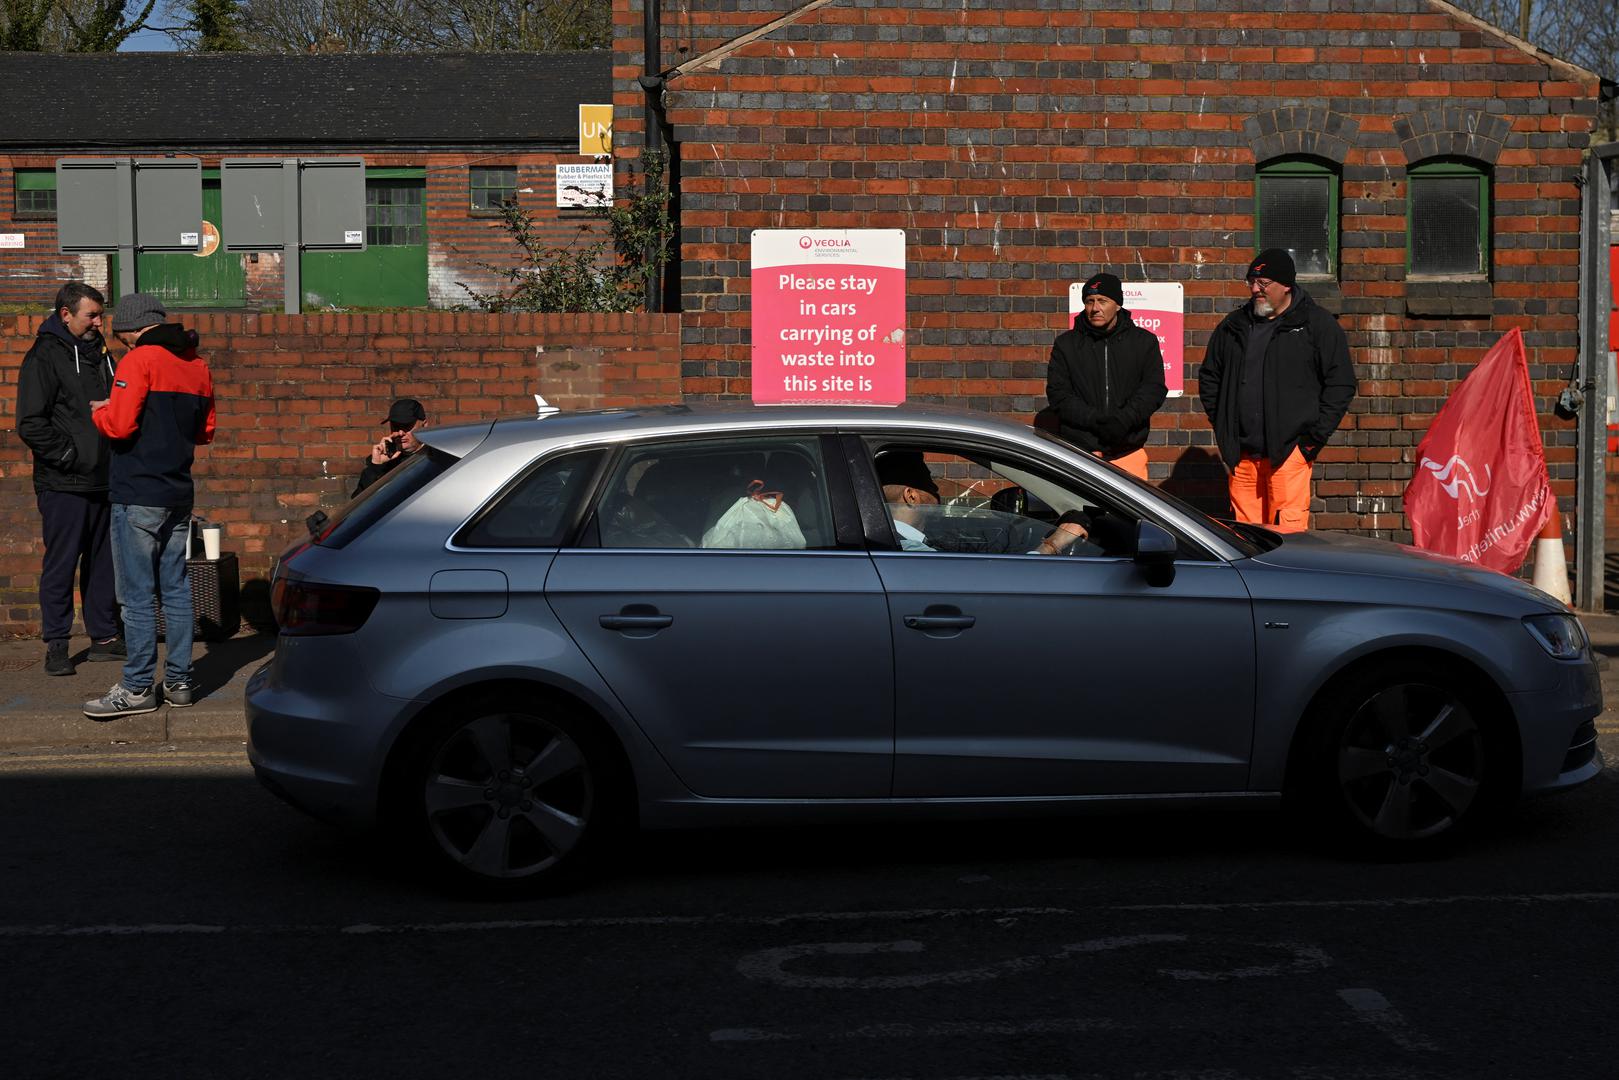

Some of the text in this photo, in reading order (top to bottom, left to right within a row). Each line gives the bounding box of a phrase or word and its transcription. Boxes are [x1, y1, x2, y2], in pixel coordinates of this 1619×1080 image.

[814, 239, 851, 247] VEOLIA
[779, 274, 878, 295] Please stay
[800, 299, 857, 315] in cars
[1132, 316, 1160, 330] stop
[779, 324, 877, 346] carrying of
[781, 350, 875, 366] waste into
[784, 375, 873, 391] this site is
